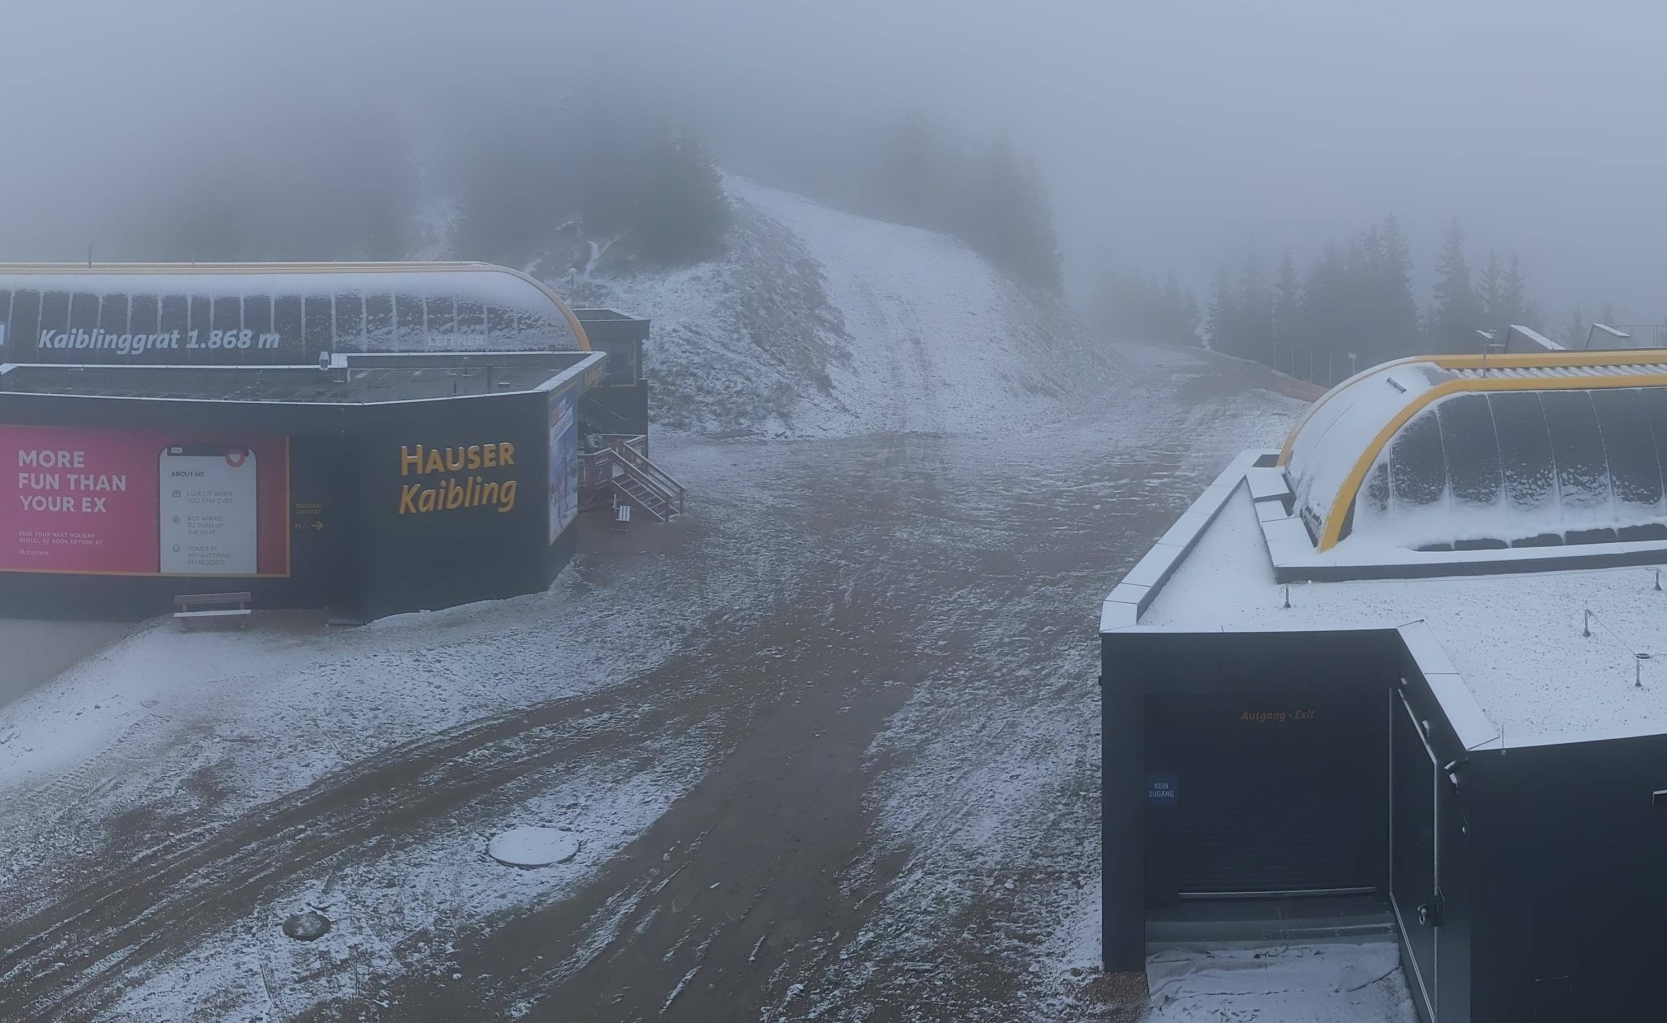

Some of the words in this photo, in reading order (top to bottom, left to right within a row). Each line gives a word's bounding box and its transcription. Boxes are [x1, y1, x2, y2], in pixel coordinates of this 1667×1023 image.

[38, 329, 180, 355] Kaiblinggrat
[185, 329, 252, 349] 1.868
[257, 332, 281, 349] m
[428, 337, 483, 346] LEITNER
[18, 449, 85, 468] MORE
[400, 441, 515, 476] HAUSER
[18, 472, 60, 490] FUN
[66, 474, 126, 491] THAN
[20, 495, 75, 512] YOUR
[81, 496, 107, 513] EX
[399, 475, 517, 515] Kaibling
[1241, 710, 1286, 723] Ausgang
[1295, 709, 1315, 719] Exit
[1149, 790, 1174, 798] ZUGANG
